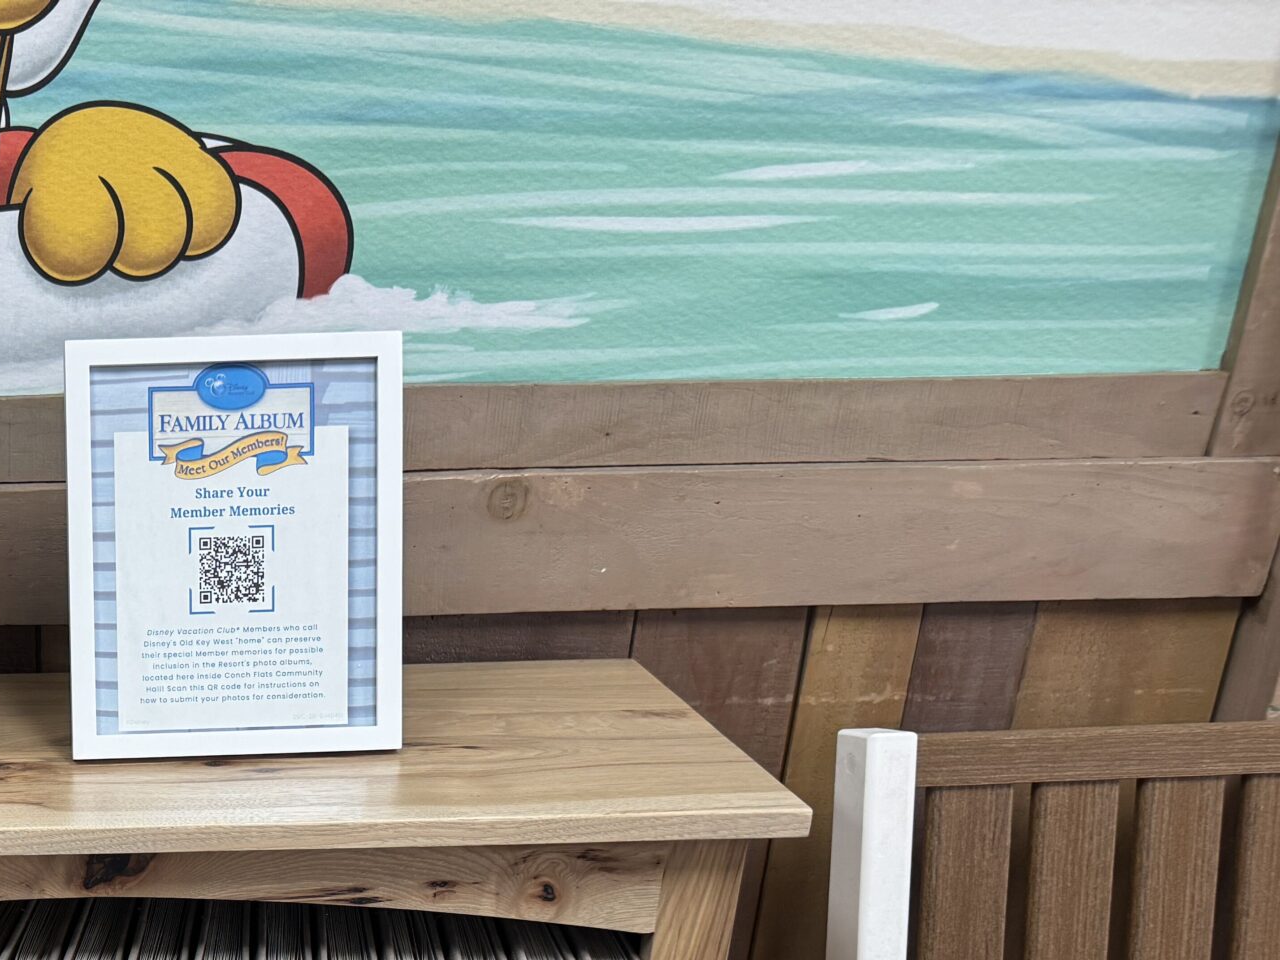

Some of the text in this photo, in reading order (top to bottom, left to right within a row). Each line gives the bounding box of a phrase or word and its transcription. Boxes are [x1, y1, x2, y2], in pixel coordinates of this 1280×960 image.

[158, 411, 305, 433] FAMILY ALBUM
[177, 436, 285, 476] Meet Our Members!
[195, 486, 270, 500] Share Your
[170, 503, 296, 519] Member Memories
[146, 628, 175, 637] Disney
[177, 627, 214, 635] Vacation
[242, 625, 281, 633] Members
[143, 639, 177, 648] Disney's
[195, 639, 211, 647] Key
[285, 636, 322, 644] preserve
[141, 651, 161, 659] their
[163, 650, 194, 660] special
[231, 648, 273, 656] memories
[275, 647, 287, 655] for
[289, 646, 324, 655] possible
[152, 662, 190, 670] inclusion
[218, 660, 250, 668] Resort's
[253, 660, 278, 668] photo
[279, 658, 313, 666] albums,
[197, 672, 222, 680] inside
[224, 671, 251, 679] Conch
[253, 670, 273, 678] Flats
[275, 669, 324, 677] Community
[258, 681, 307, 689] instructions
[201, 696, 219, 704] your
[221, 694, 250, 703] photos
[252, 693, 264, 701] for
[266, 691, 326, 700] consideration.
